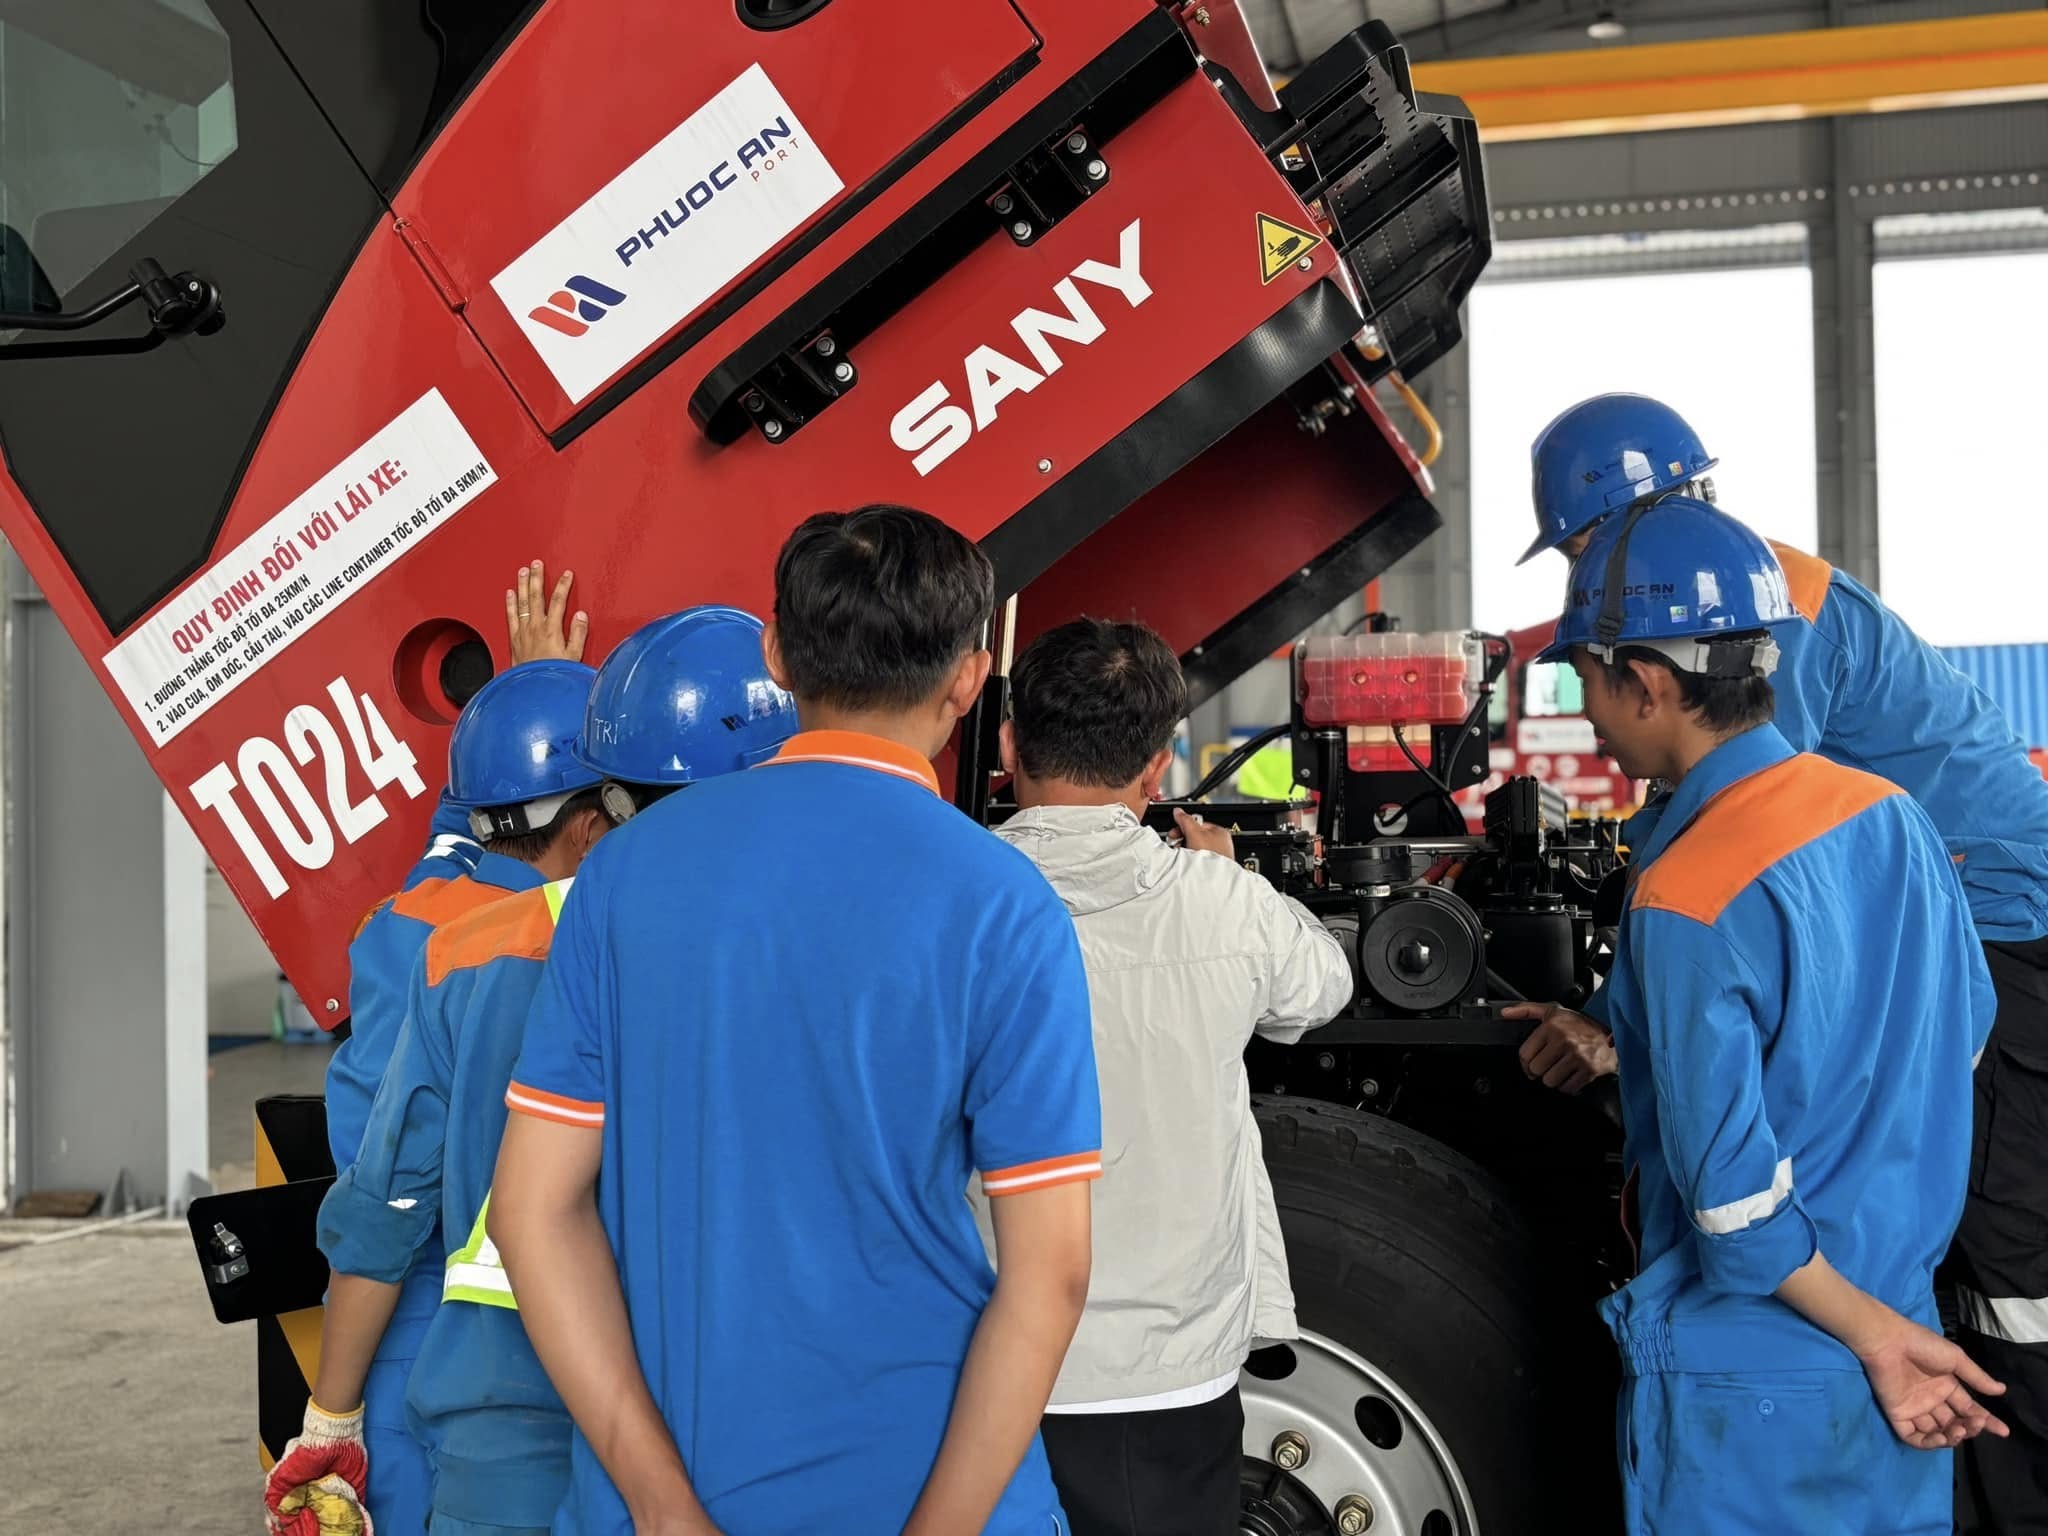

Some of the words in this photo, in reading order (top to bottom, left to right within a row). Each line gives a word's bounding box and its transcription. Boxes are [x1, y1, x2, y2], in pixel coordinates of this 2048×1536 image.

[615, 160, 738, 268] PHUOC
[737, 115, 792, 170] AN
[750, 138, 800, 182] PORT
[891, 218, 1153, 477] SANY
[144, 701, 157, 713] 1.
[211, 635, 233, 657] TỐC
[230, 623, 248, 643] ĐỘ
[243, 609, 263, 632] TỐI
[260, 601, 277, 619] ĐA
[274, 573, 311, 609] 25KM/H
[156, 719, 169, 733] 2.
[165, 703, 187, 724] VÀO
[184, 687, 210, 710] CUA,
[220, 657, 248, 680] DỐC,
[261, 625, 287, 647] TÀU,
[282, 608, 305, 630] VÀO
[302, 592, 324, 615] CÁC
[320, 575, 345, 600] LINE
[342, 536, 395, 583] CONTAINER
[390, 521, 414, 544] TỐC
[410, 507, 428, 529] ĐỘ
[424, 494, 445, 517] TỐI
[440, 486, 460, 504] ĐA
[455, 461, 489, 493] 5KM/H
[172, 608, 214, 655] QUY
[211, 569, 266, 623] ĐỊNH
[260, 535, 303, 582] ĐỐI
[296, 510, 340, 551] VỚI
[334, 482, 373, 523] LÁI
[367, 459, 408, 497] XE:
[188, 675, 427, 900] T024
